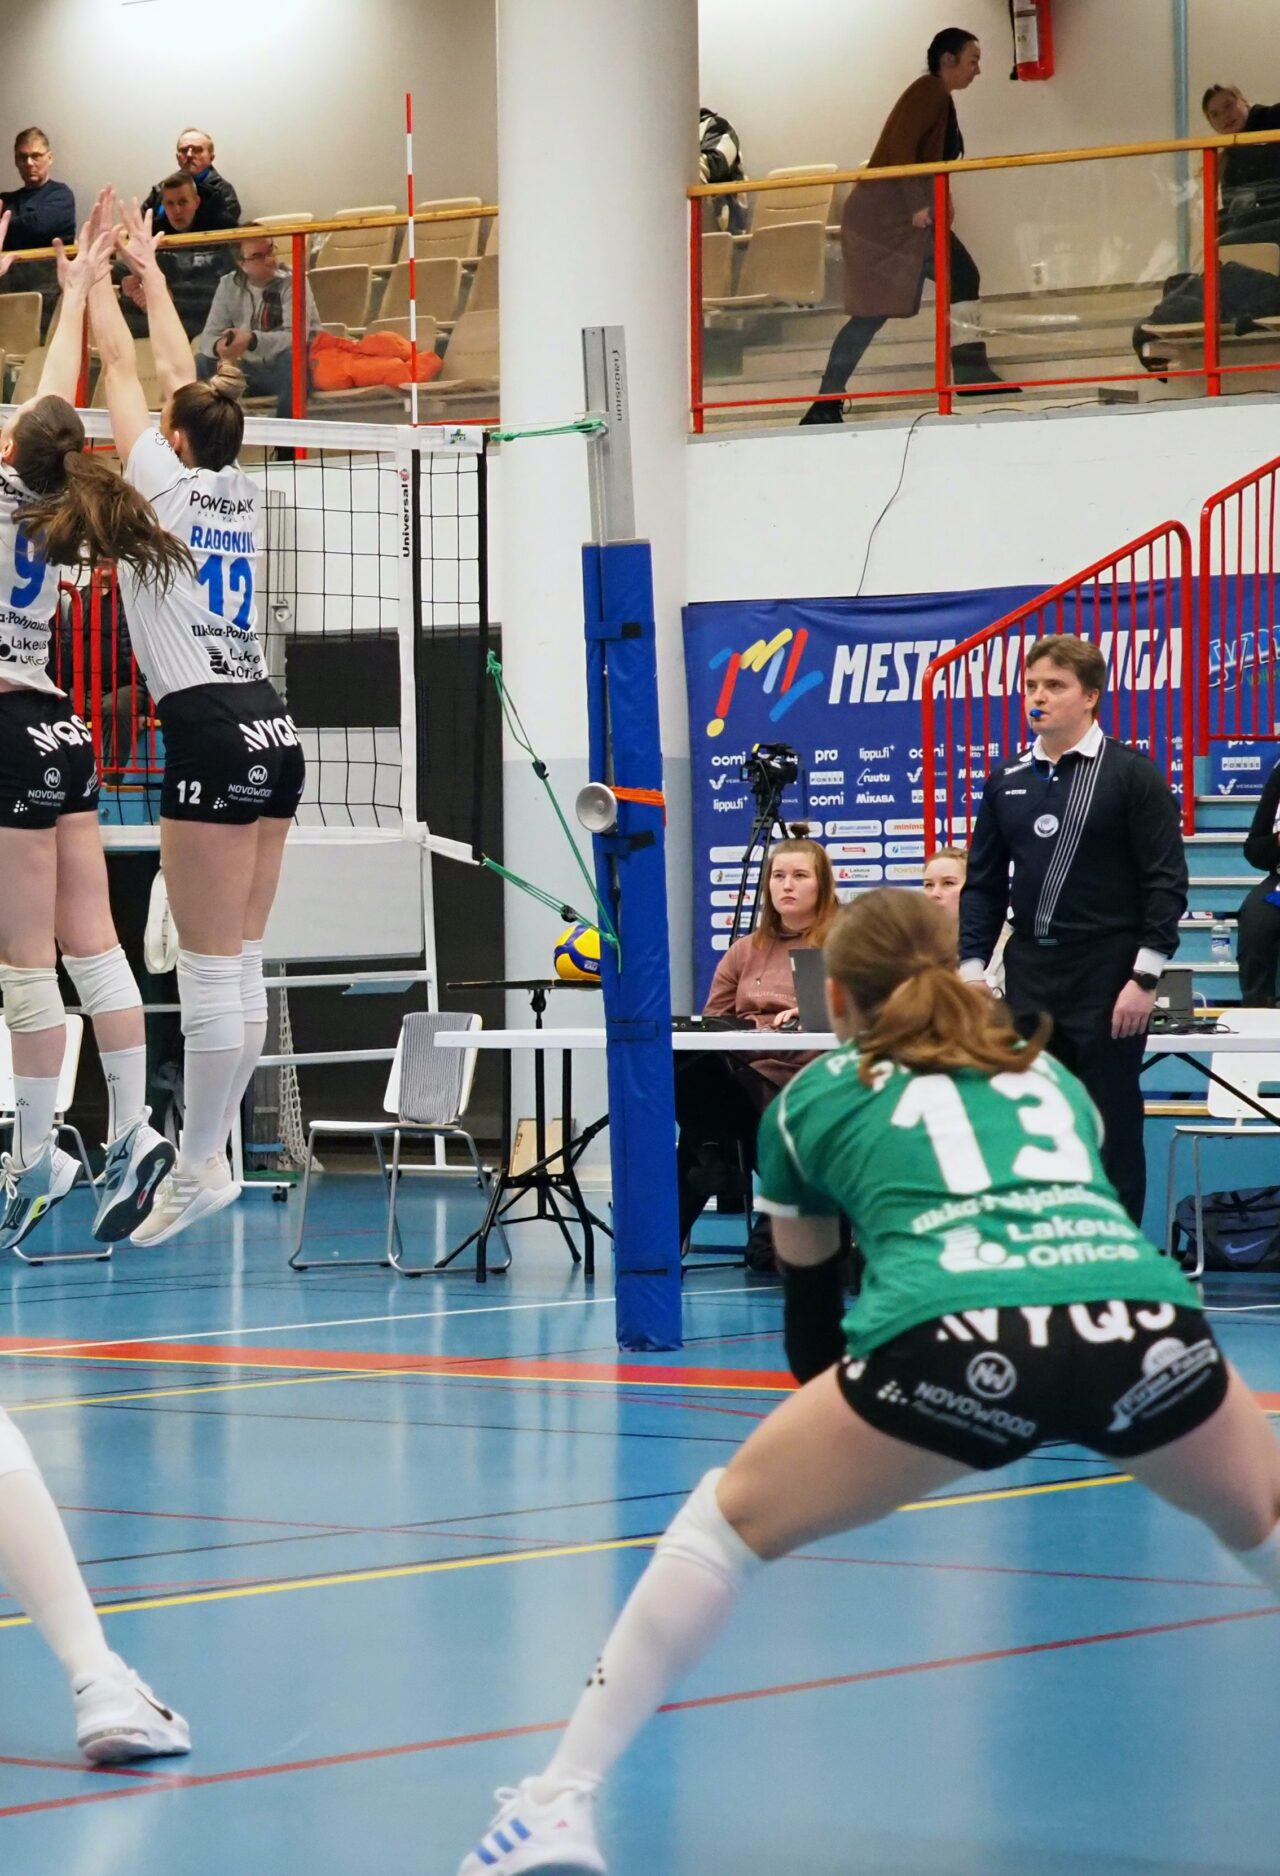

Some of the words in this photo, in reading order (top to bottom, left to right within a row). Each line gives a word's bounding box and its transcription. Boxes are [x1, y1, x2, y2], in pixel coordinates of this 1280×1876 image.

[402, 484, 410, 557] Universal
[10, 519, 48, 608] 9
[195, 553, 252, 631] 12
[828, 627, 1183, 704] MESTARUIIGA
[711, 751, 746, 766] oomi
[815, 749, 838, 764] pro
[863, 772, 890, 783] ruutu
[177, 780, 202, 804] 12
[809, 791, 844, 806] oomi
[890, 1072, 1093, 1194] 13
[1007, 1216, 1136, 1243] Lakeus
[1028, 1242, 1139, 1268] Office
[914, 1381, 1036, 1438] NOVOWOOD
